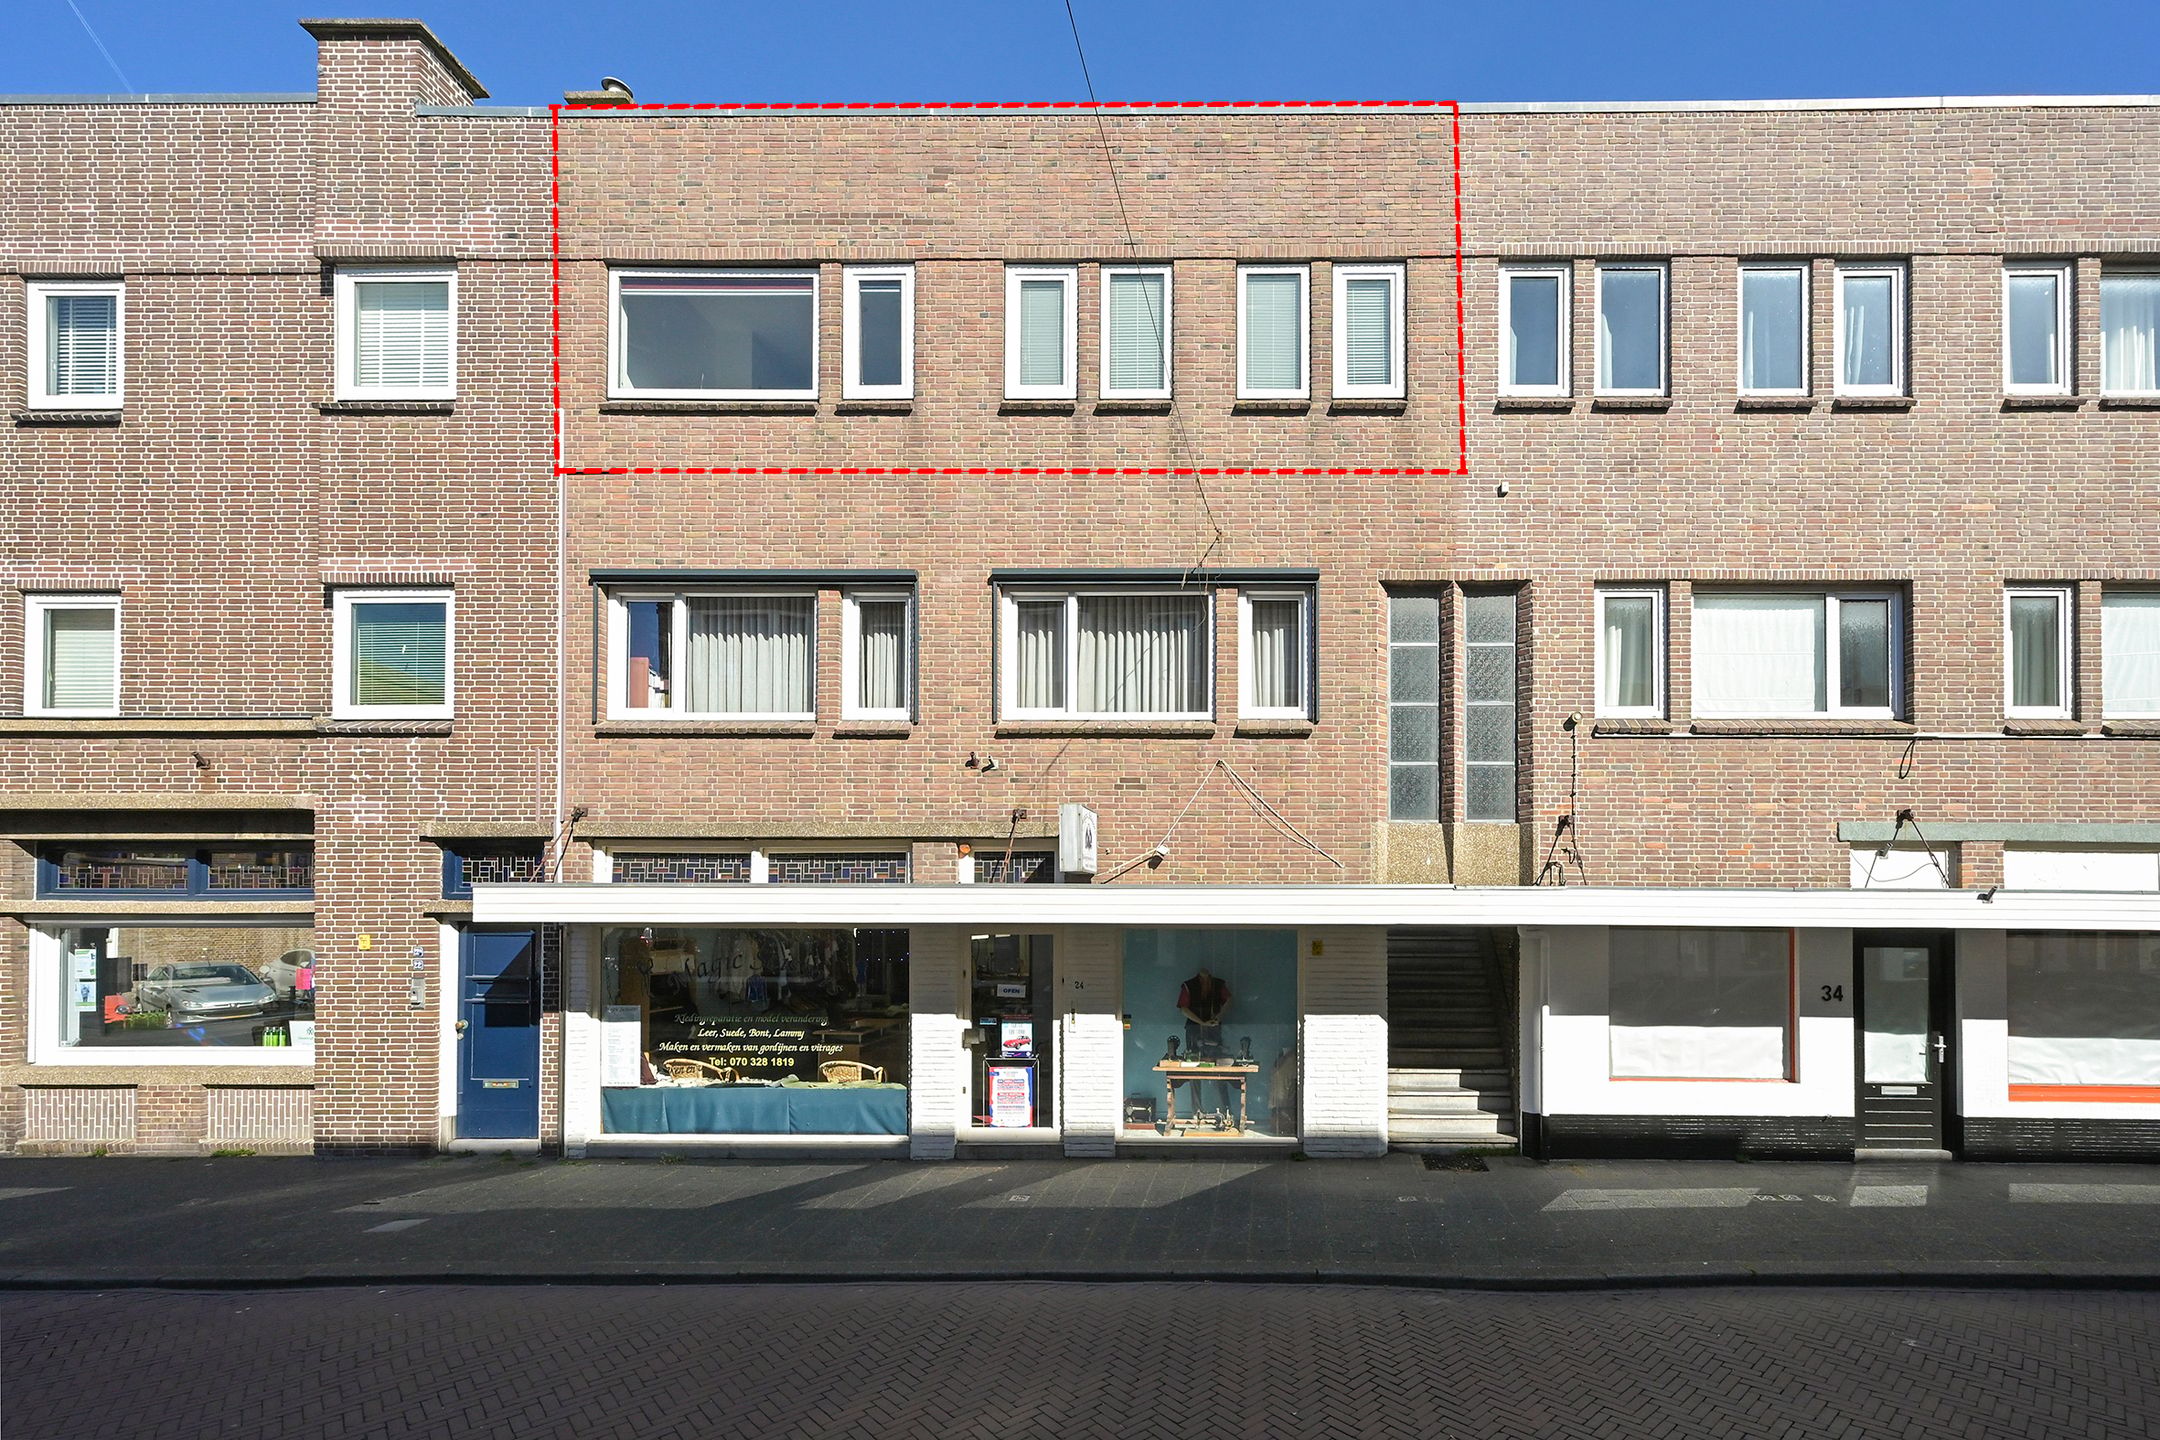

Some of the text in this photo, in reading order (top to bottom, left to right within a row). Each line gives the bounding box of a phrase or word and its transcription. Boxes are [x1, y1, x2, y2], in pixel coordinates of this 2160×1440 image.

[1074, 981, 1084, 989] 24
[1821, 985, 1843, 1001] 34
[674, 1013, 742, 1025] Kledingreparatie
[756, 1013, 779, 1022] model
[781, 1013, 828, 1026] verandering
[697, 1027, 805, 1041] Leer, Suede, Bont, Lammy
[659, 1041, 689, 1053] Maken
[701, 1041, 741, 1053] vermaken
[758, 1042, 798, 1055] gordijnen
[811, 1043, 843, 1055] vitrages
[709, 1057, 795, 1067] Tel: 070 328 1819
